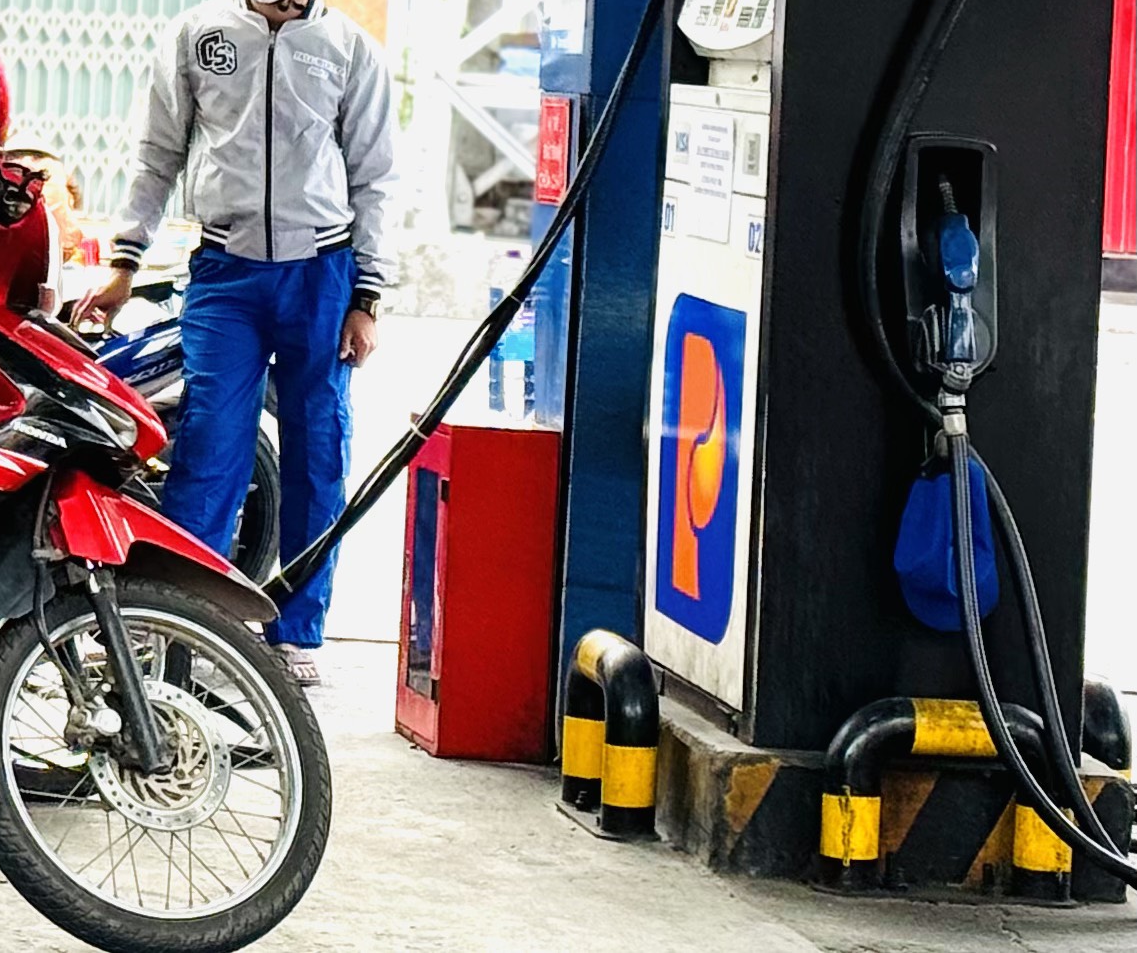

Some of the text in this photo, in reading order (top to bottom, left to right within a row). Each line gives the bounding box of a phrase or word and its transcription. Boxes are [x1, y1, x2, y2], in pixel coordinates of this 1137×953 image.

[665, 202, 675, 232] 01
[748, 221, 762, 254] 02
[14, 421, 68, 448] HONDA
